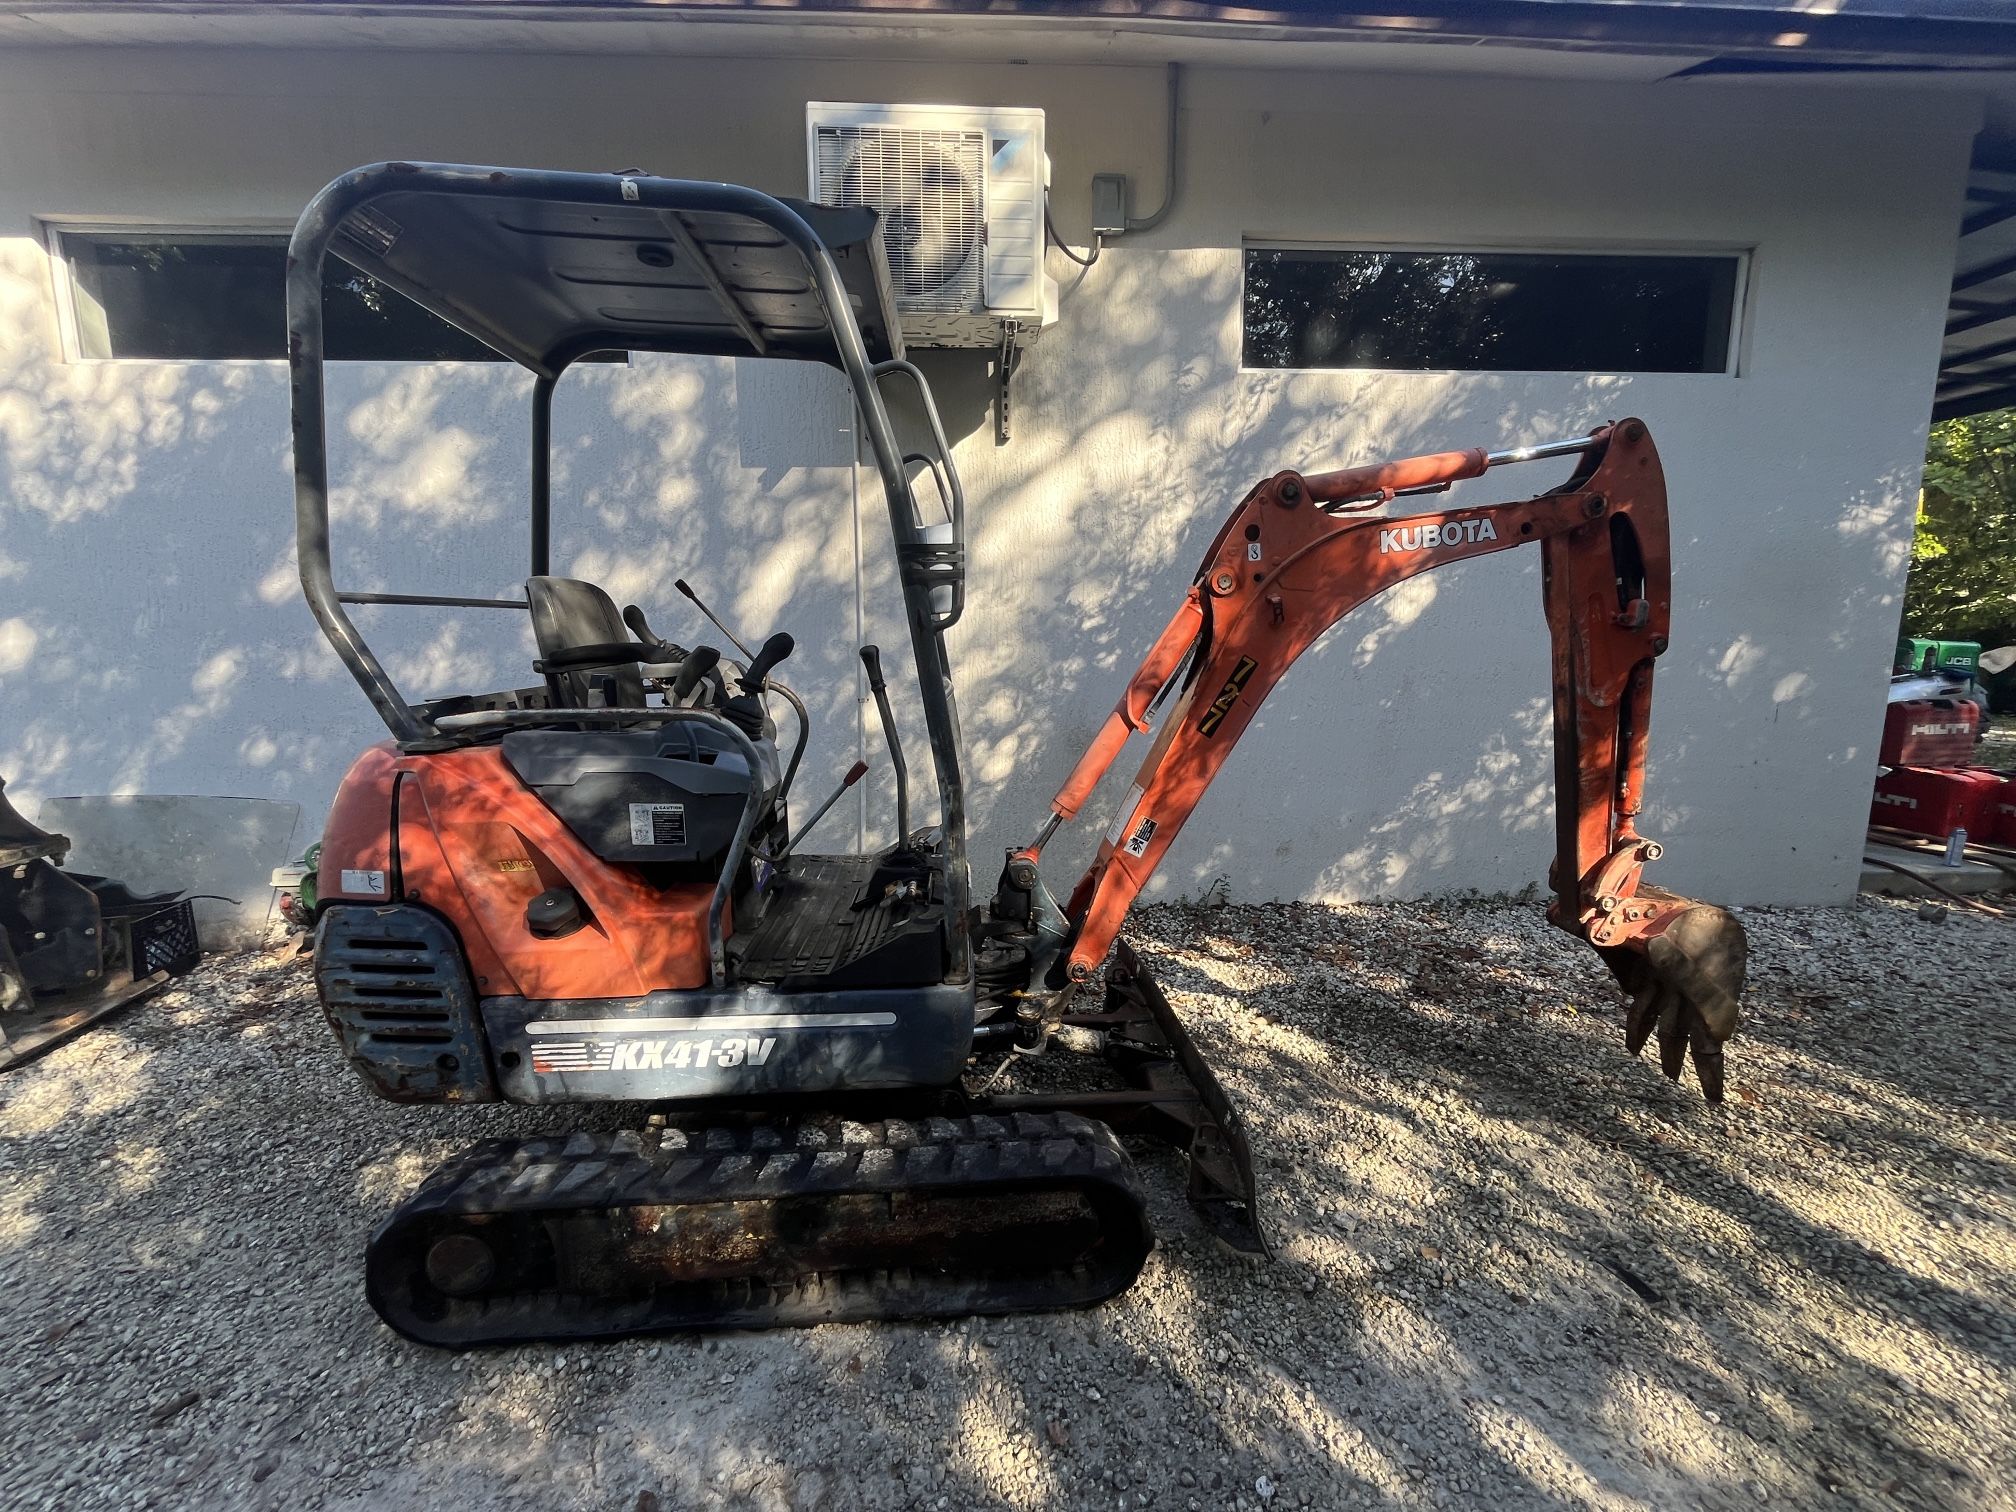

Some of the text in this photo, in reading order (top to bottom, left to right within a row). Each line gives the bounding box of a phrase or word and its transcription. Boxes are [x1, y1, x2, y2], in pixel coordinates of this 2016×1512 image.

[1380, 518, 1497, 554] KUBOTA
[1946, 657, 1972, 666] JCB
[1201, 655, 1256, 733] 727
[1911, 722, 1970, 736] HILTI
[1874, 791, 1917, 809] LTI
[611, 1037, 777, 1071] KX41-3V
